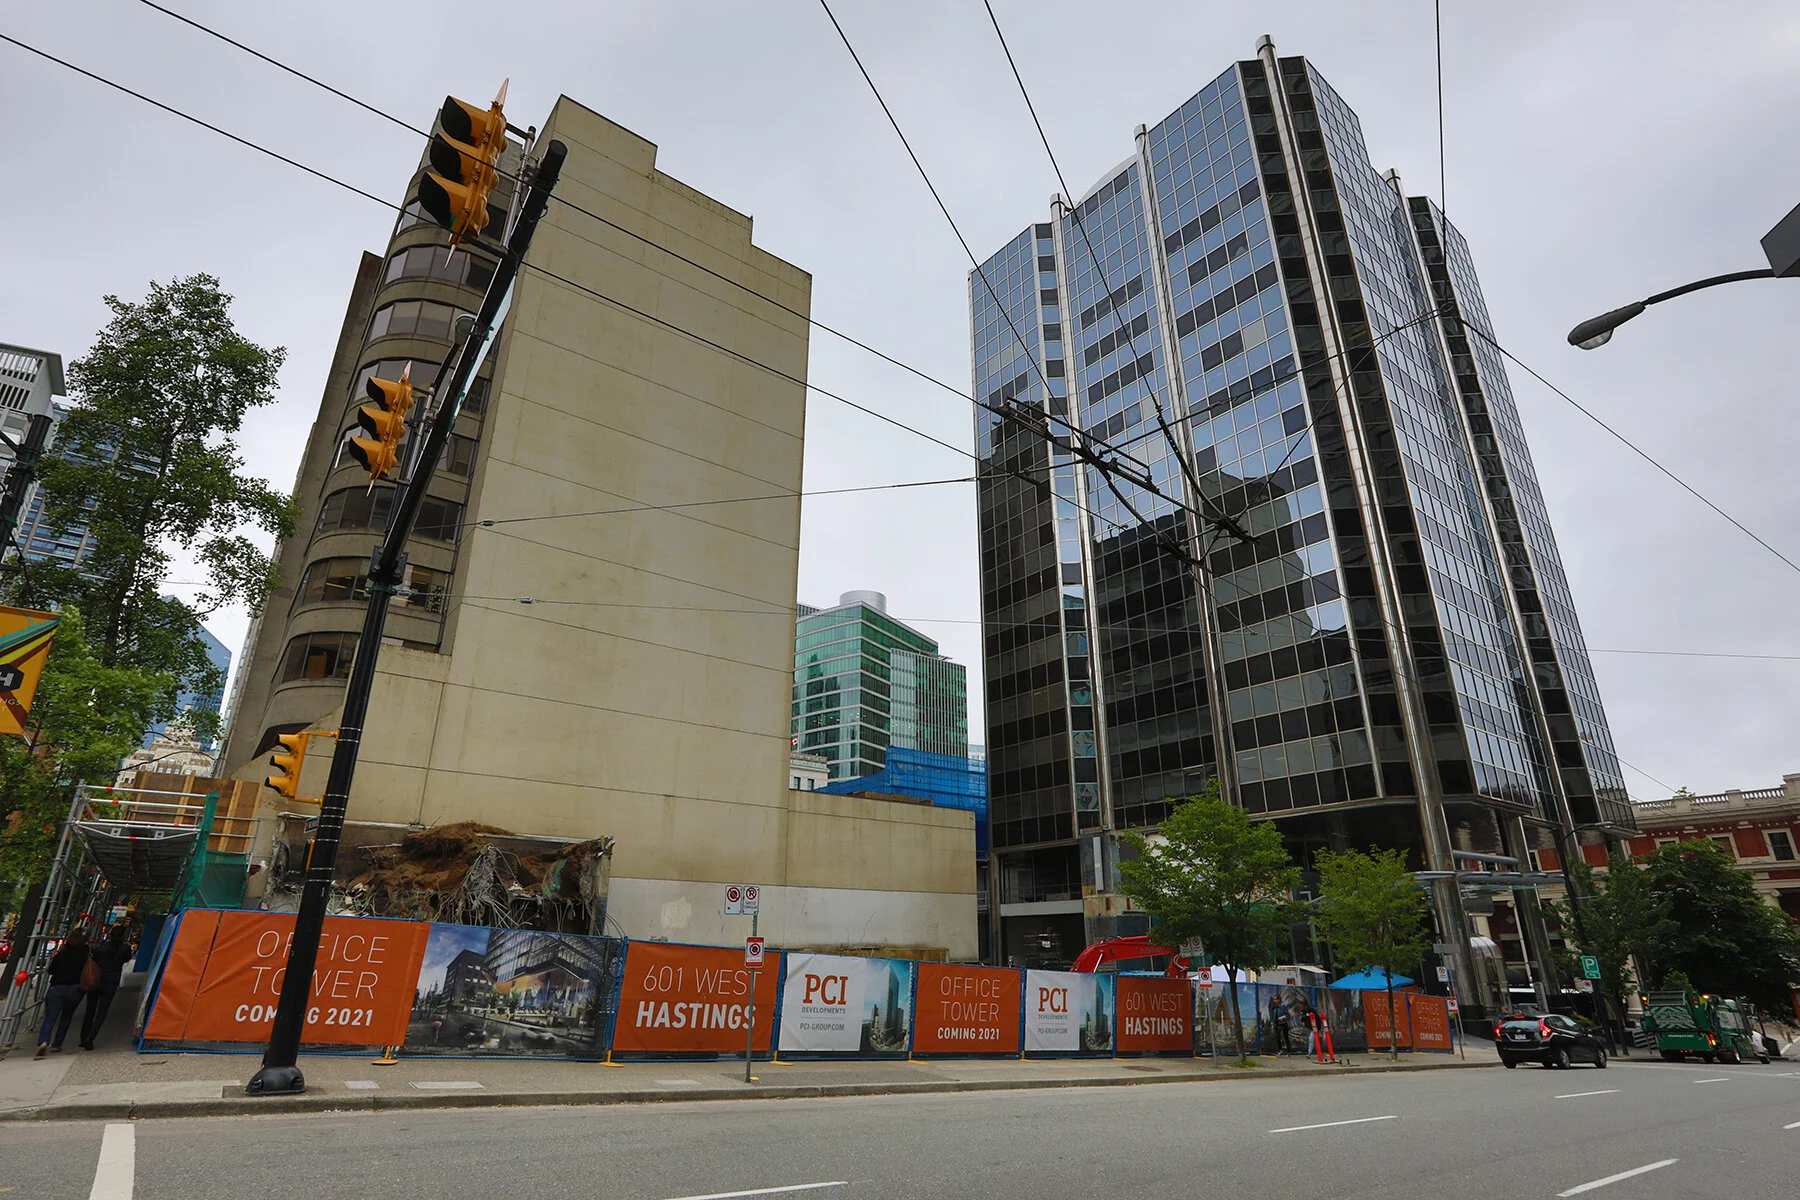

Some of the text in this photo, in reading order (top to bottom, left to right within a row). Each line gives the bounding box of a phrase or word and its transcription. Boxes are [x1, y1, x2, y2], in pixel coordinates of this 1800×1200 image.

[643, 964, 762, 995] 601 WEST
[802, 974, 849, 1005] PCI
[940, 976, 1000, 998] OFFICE
[801, 1006, 846, 1014] DEVELOPMENTS
[1038, 987, 1068, 1013] PCI
[1125, 992, 1183, 1012] 601 WEST
[1372, 998, 1399, 1013] OFFE
[235, 1004, 373, 1027] COMG 2021
[636, 1001, 757, 1030] HASTINGS
[940, 1001, 999, 1021] TOWER
[937, 1027, 1000, 1040] COMING 2021
[1125, 1017, 1183, 1036] HASTINGS
